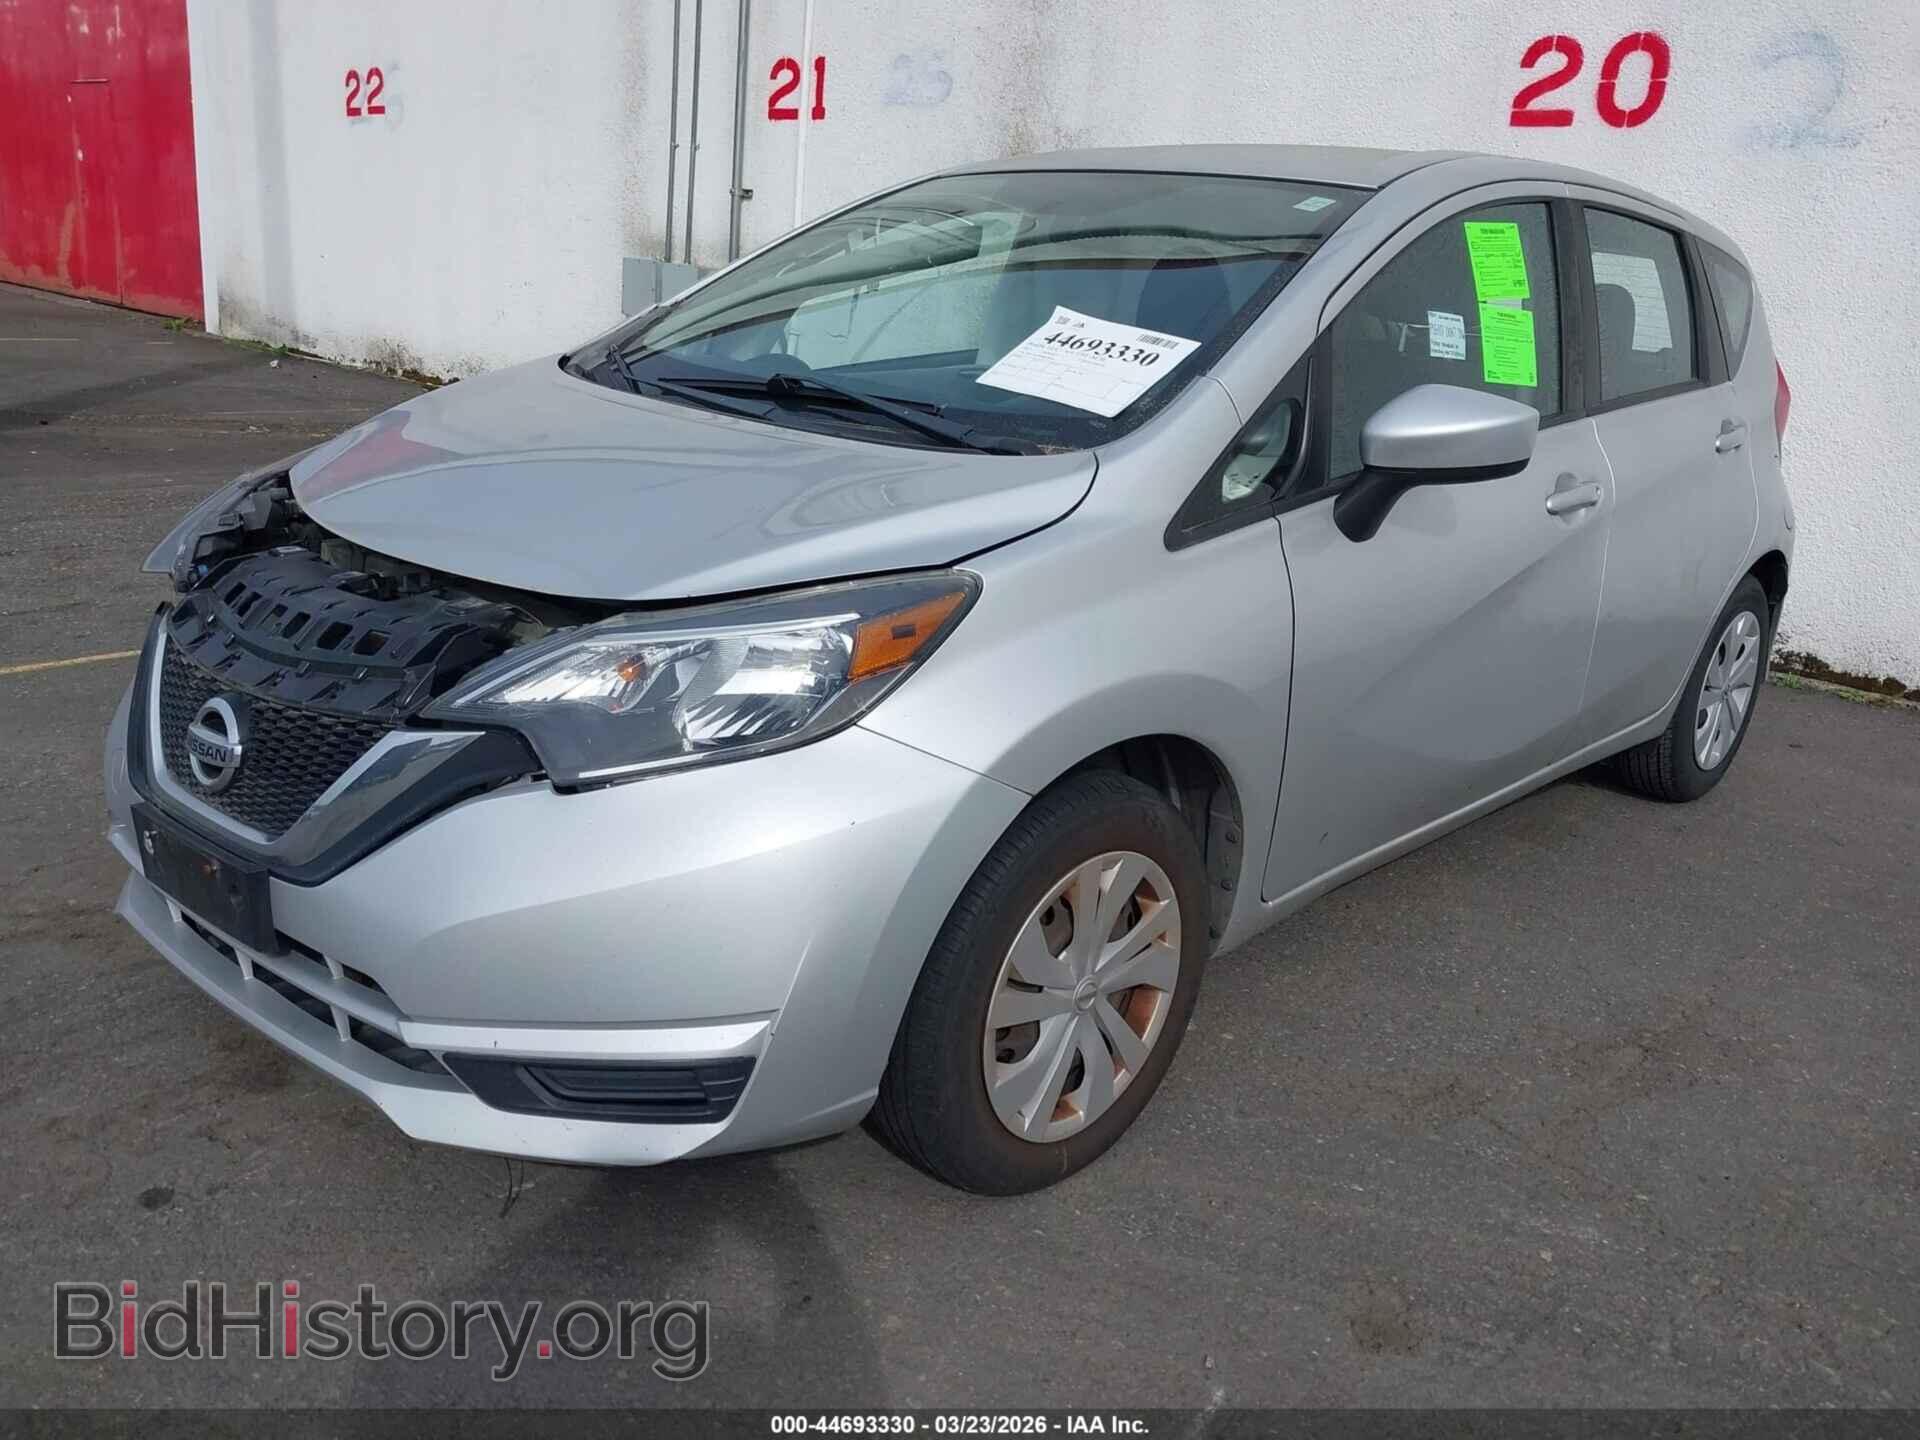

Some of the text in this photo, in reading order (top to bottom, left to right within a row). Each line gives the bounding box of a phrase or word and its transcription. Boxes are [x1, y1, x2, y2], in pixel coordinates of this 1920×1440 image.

[345, 67, 385, 117] 22
[767, 56, 827, 121] 21
[1509, 31, 1671, 129] 20
[1044, 331, 1160, 366] 44693330
[189, 735, 228, 762] SSAN
